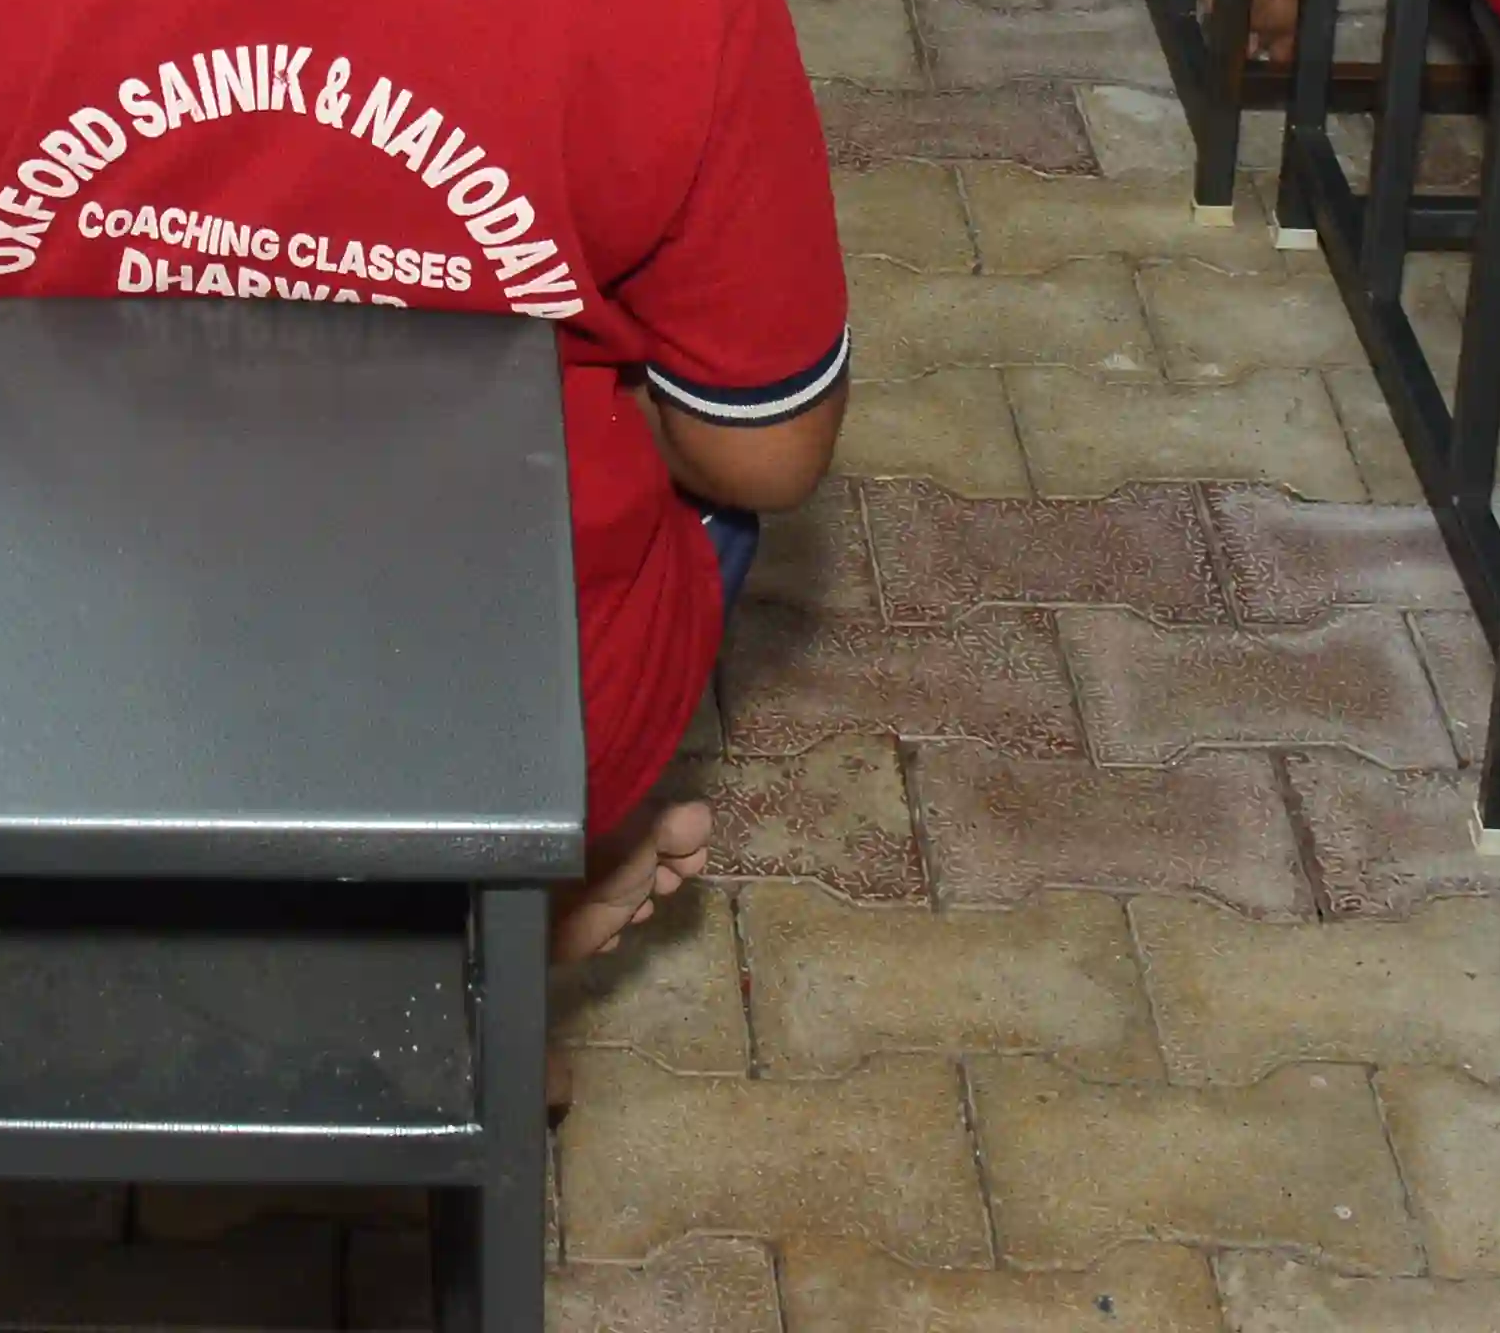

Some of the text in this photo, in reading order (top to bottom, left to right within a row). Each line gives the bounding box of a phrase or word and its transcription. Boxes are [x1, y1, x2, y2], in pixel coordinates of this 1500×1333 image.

[119, 44, 312, 138] SAINIK
[315, 57, 351, 129] &
[78, 201, 473, 291] COACHING CLASSES
